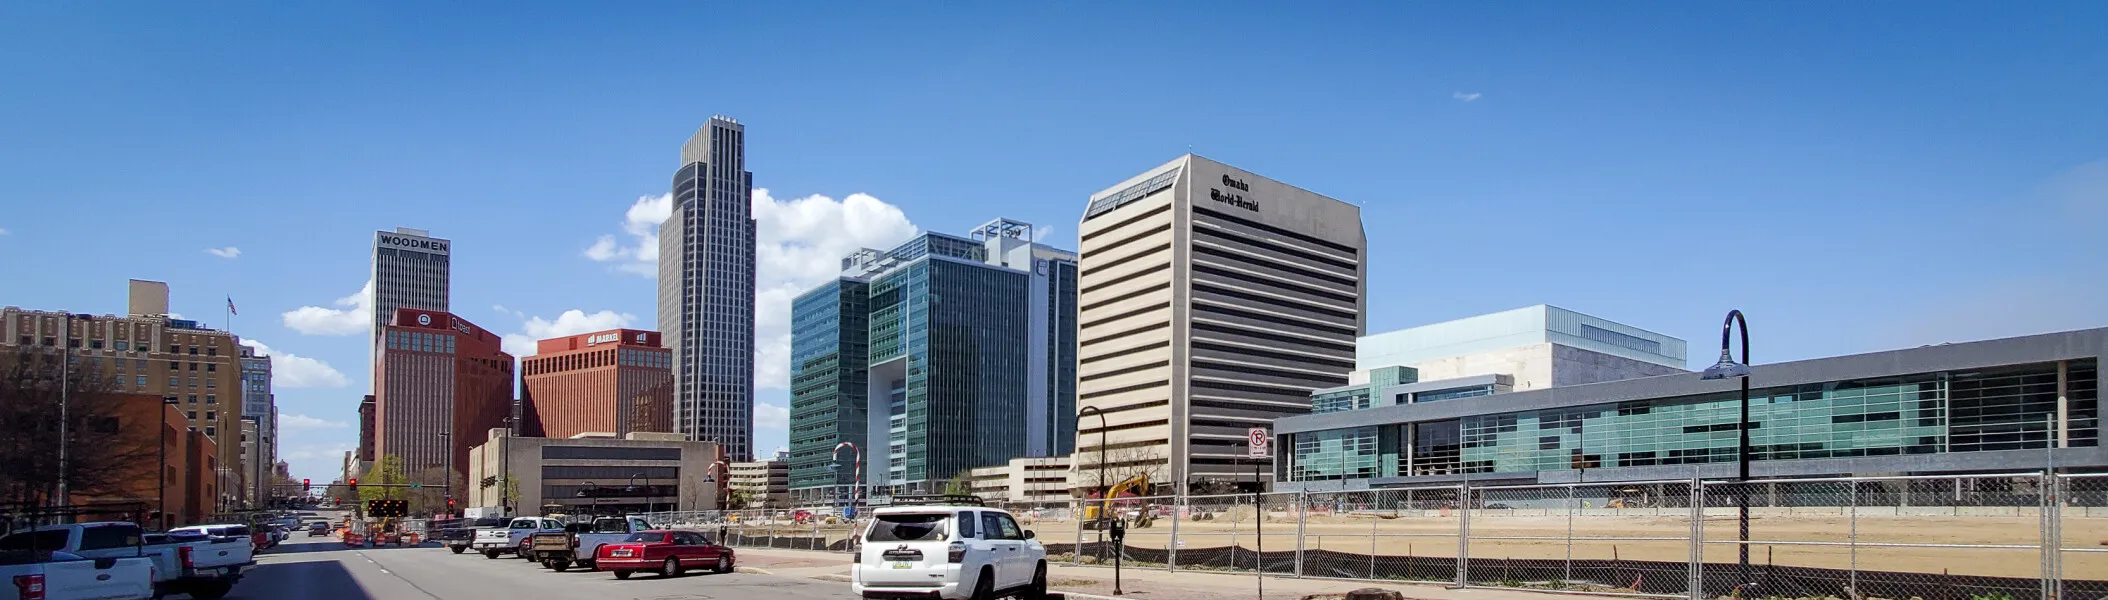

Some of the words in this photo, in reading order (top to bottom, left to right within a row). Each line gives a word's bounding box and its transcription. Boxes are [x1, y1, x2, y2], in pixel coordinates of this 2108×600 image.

[1222, 173, 1249, 192] Omaha
[1210, 187, 1259, 212] World-Herald
[381, 235, 447, 251] WOODMEN
